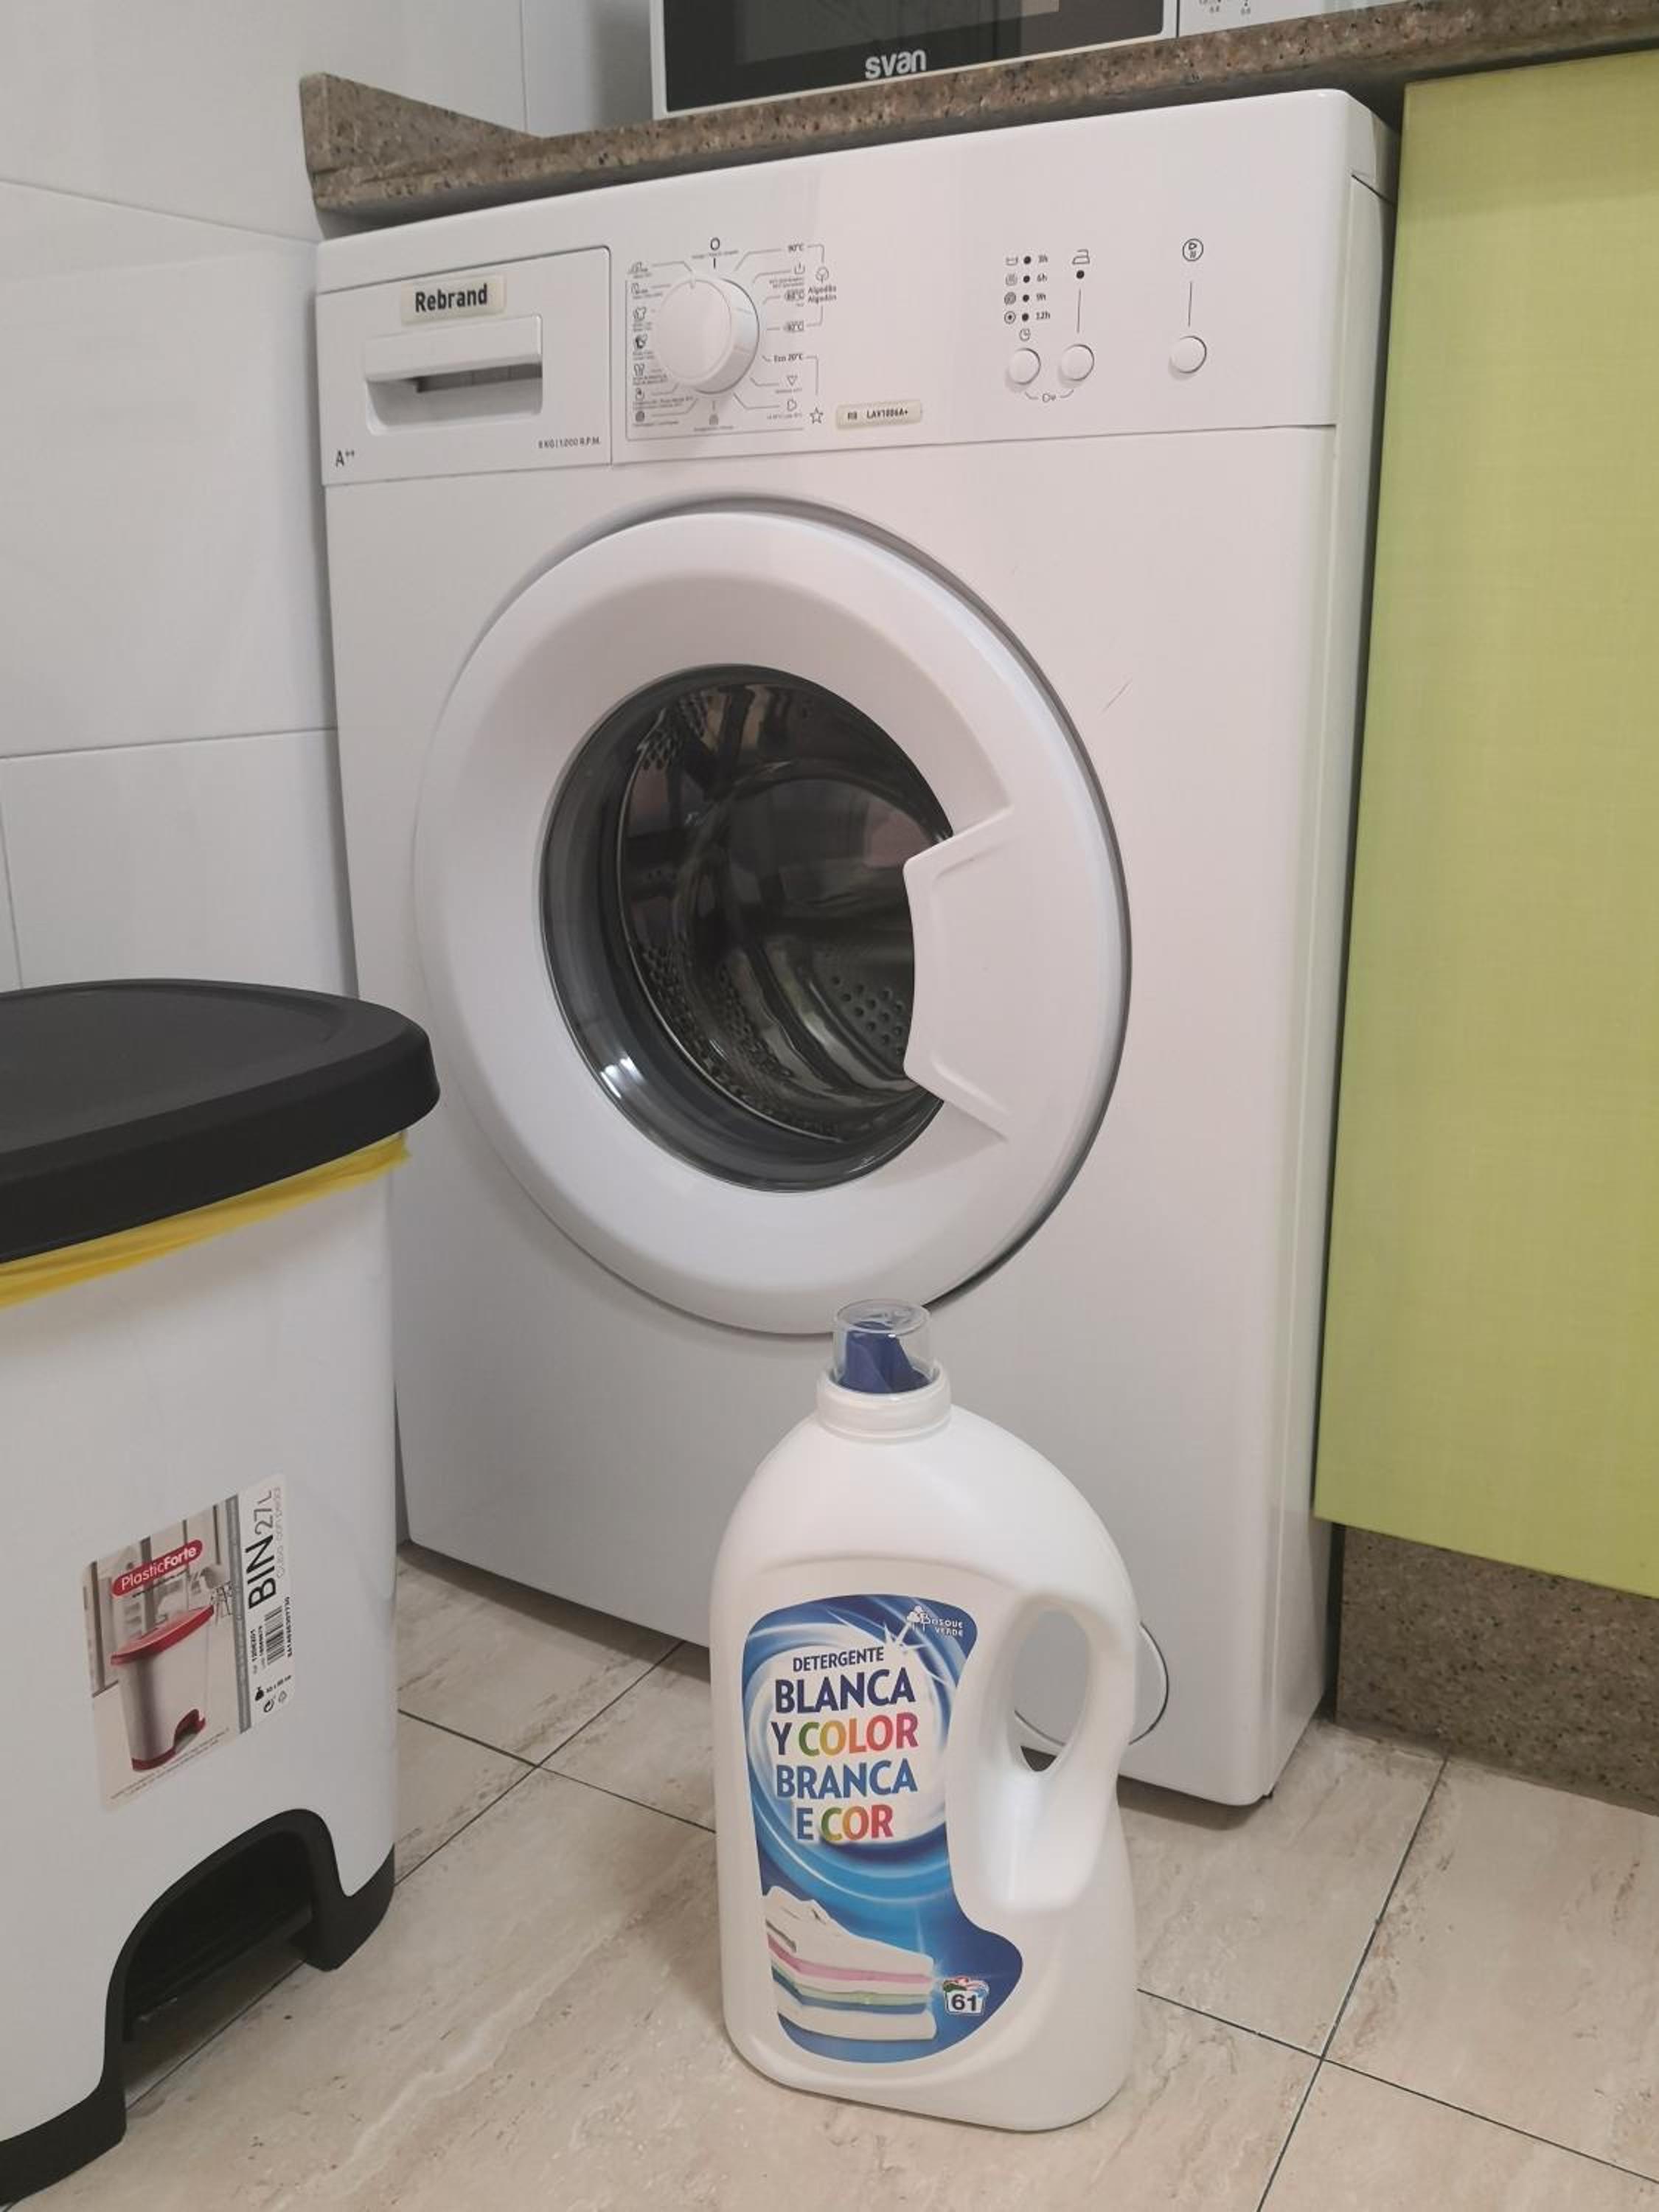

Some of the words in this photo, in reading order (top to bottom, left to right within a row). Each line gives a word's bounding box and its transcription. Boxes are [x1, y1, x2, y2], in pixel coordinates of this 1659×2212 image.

[865, 49, 926, 80] svan
[415, 283, 489, 313] Rebrand
[121, 1546, 197, 1590] PlasticForte
[245, 1534, 277, 1610] BIN
[793, 1646, 885, 1672] DETERGENTE
[775, 1666, 916, 1714] BLANCA
[771, 1721, 793, 1756] Y
[798, 1711, 919, 1757] COLOR
[776, 1758, 918, 1800] BRANCA
[796, 1806, 814, 1841] E
[820, 1804, 894, 1842] COR
[951, 1993, 978, 2011] 61
